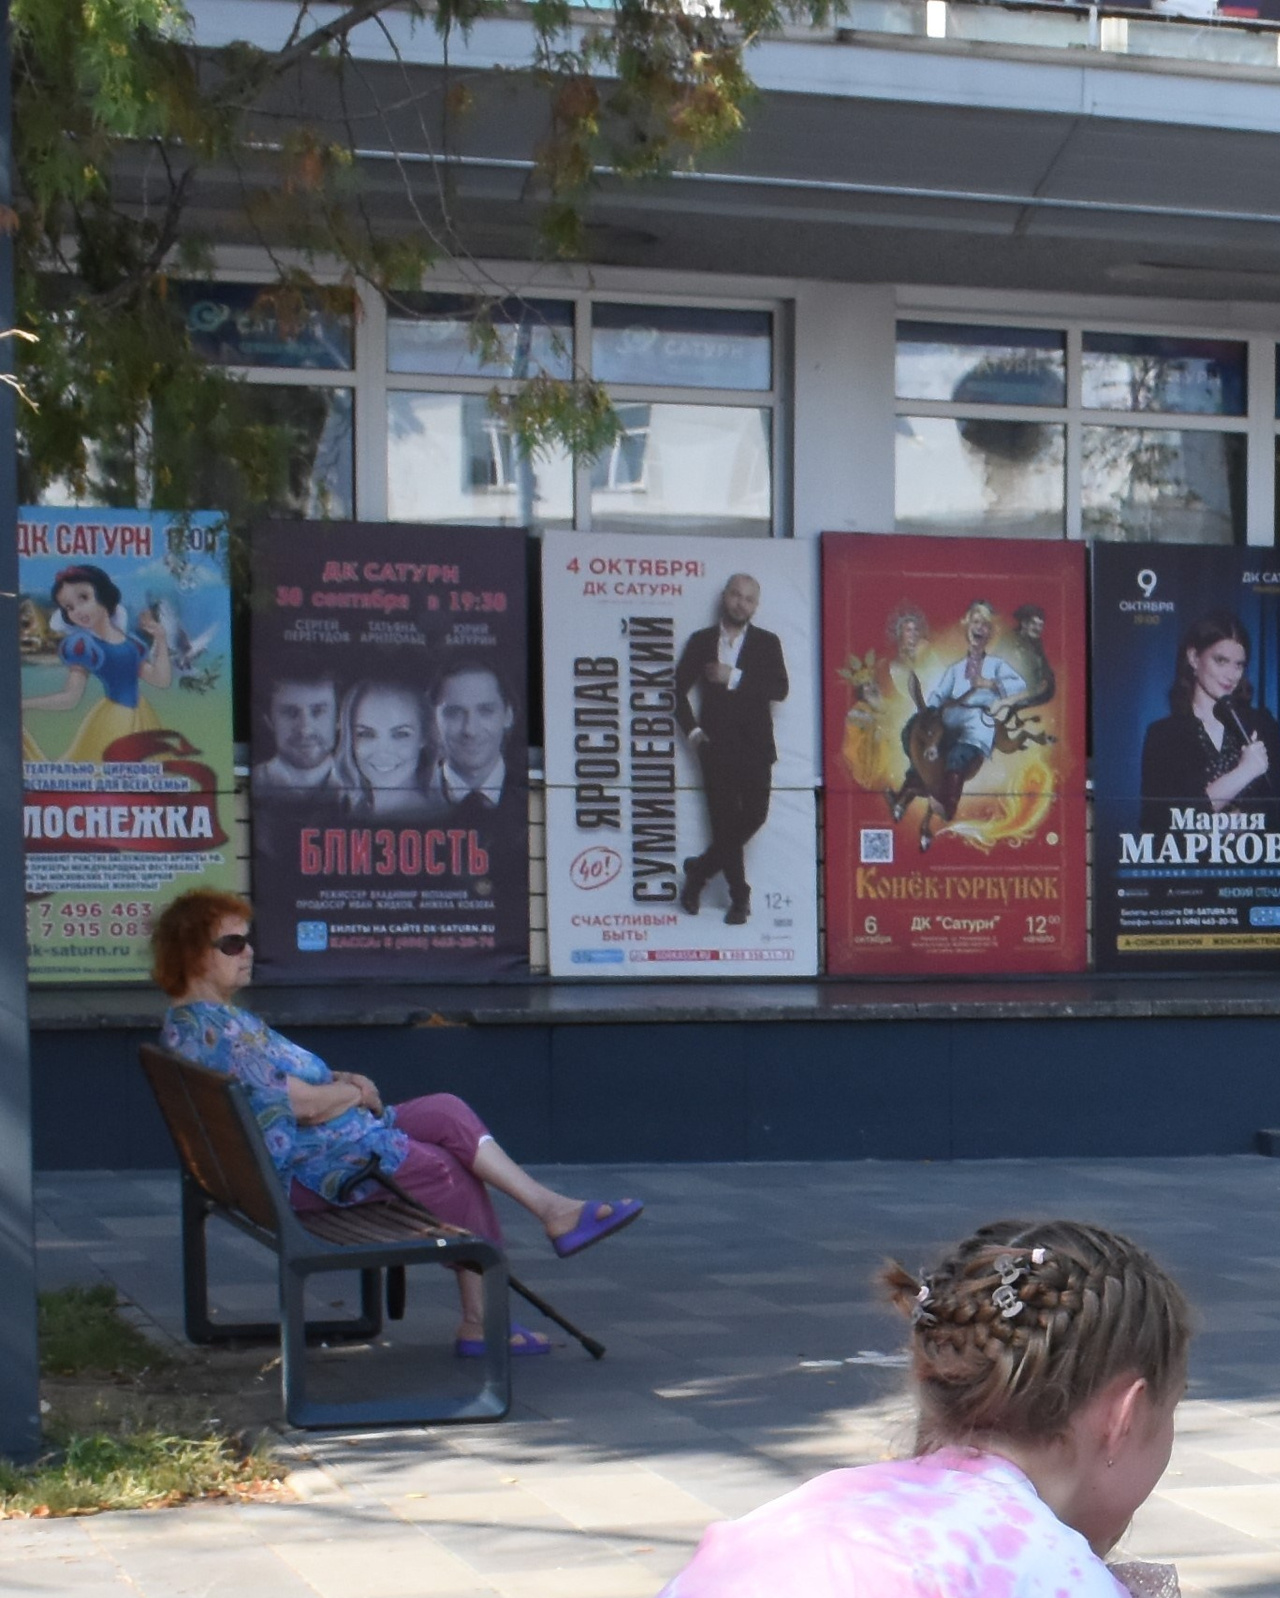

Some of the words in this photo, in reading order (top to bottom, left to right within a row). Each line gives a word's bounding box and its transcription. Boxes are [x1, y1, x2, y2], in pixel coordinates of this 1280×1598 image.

[17, 522, 48, 557] ДК
[56, 524, 151, 556] САТУРН
[322, 561, 359, 583] ДК
[363, 562, 460, 584] САТУРН
[566, 557, 580, 574] 4
[589, 557, 699, 577] ОКТЯБРЯ
[1137, 568, 1158, 598] 9
[1242, 571, 1260, 584] ДК
[582, 581, 607, 596] ДК
[613, 582, 683, 596] САТУРН
[1119, 600, 1175, 612] ОКТЯБРЯ
[574, 656, 621, 829] ЯРОСЛАВ
[620, 616, 678, 902] СУМИШЕВСКИЙ
[152, 779, 189, 791] СЕМЬИ
[23, 805, 214, 839] ЛОСНЕЖКА
[1169, 807, 1266, 836] Мария
[300, 828, 490, 876] БЛИЗОСТЬ
[579, 858, 611, 882] 40!
[39, 903, 52, 917] 7
[61, 902, 102, 918] 496
[111, 902, 152, 918] 463
[763, 892, 793, 910] 12+
[42, 922, 53, 937] 7
[63, 922, 100, 937] 915
[110, 922, 151, 937] 083
[330, 924, 371, 933] БИЛЕТЫ
[373, 924, 387, 933] НА
[388, 922, 421, 933] САЙТЕ
[571, 914, 678, 927] СЧАСТЛИВЫМ
[864, 915, 877, 934] 6
[911, 916, 932, 932] ДК
[602, 929, 648, 942] БЫТЬ!
